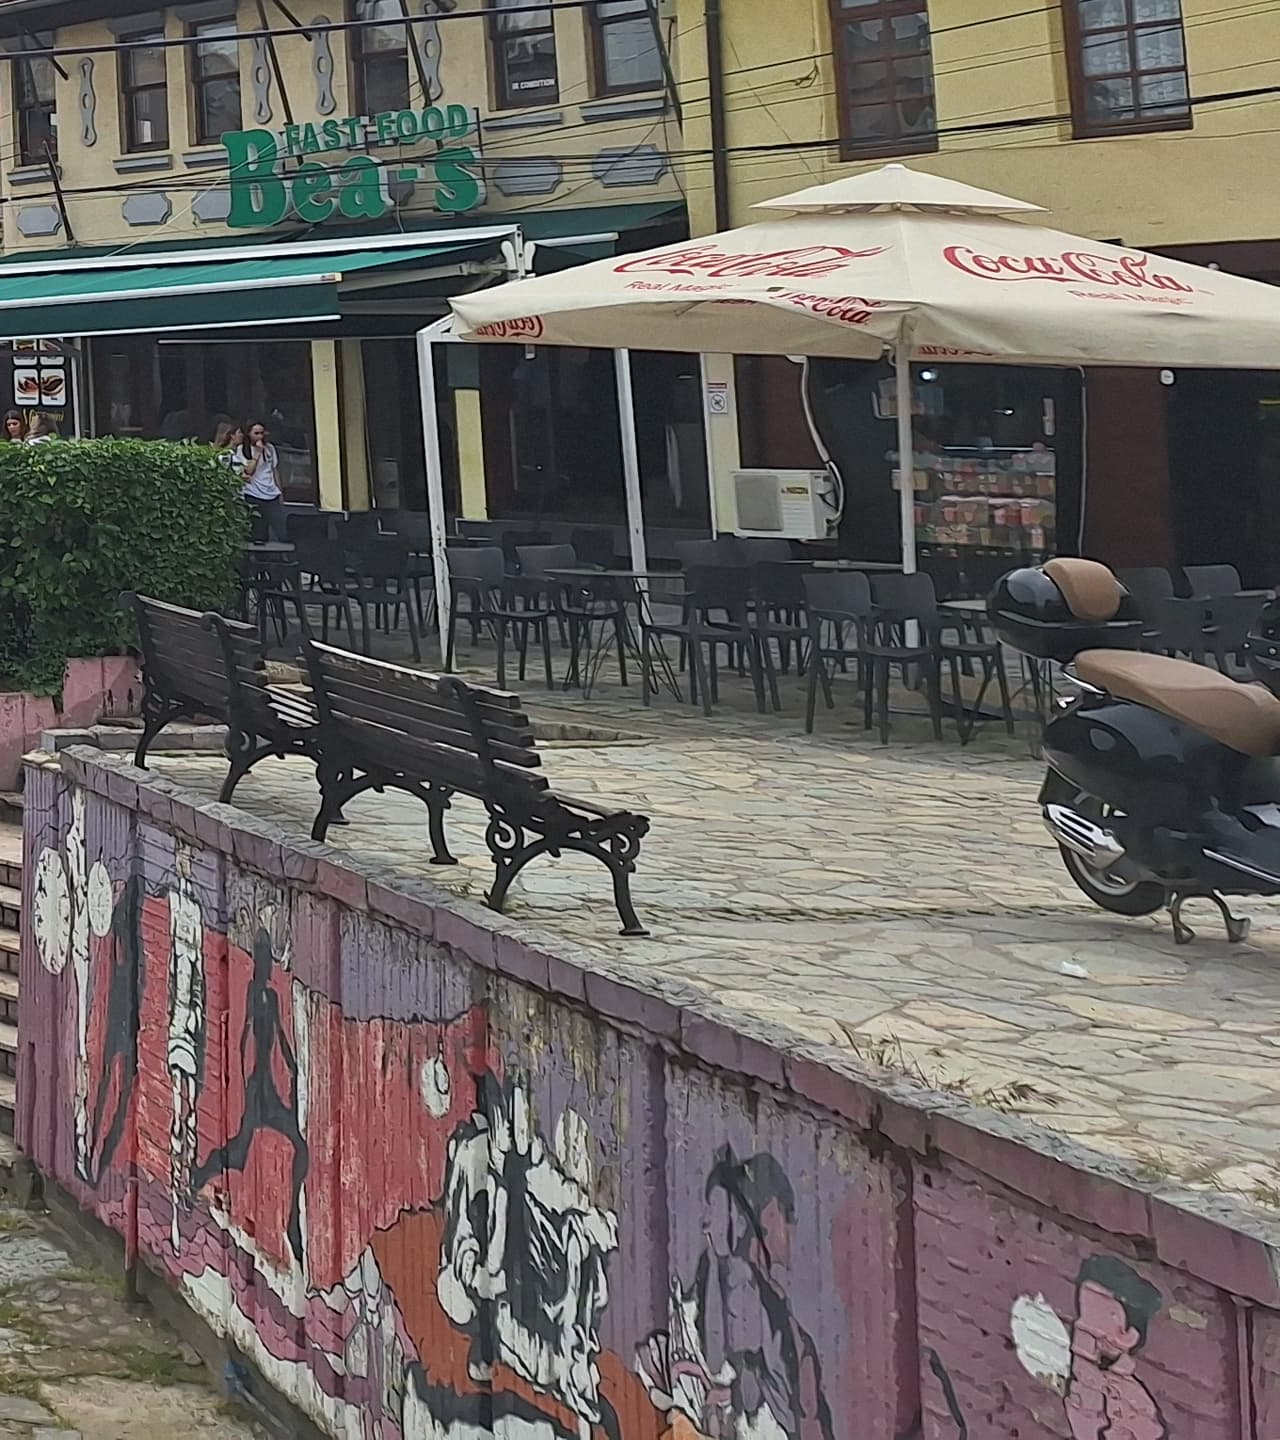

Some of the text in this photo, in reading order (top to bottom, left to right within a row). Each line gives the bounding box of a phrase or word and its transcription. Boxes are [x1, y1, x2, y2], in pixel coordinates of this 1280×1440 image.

[285, 104, 470, 155] FAST FOOD
[943, 246, 1194, 292] Coca-Cola
